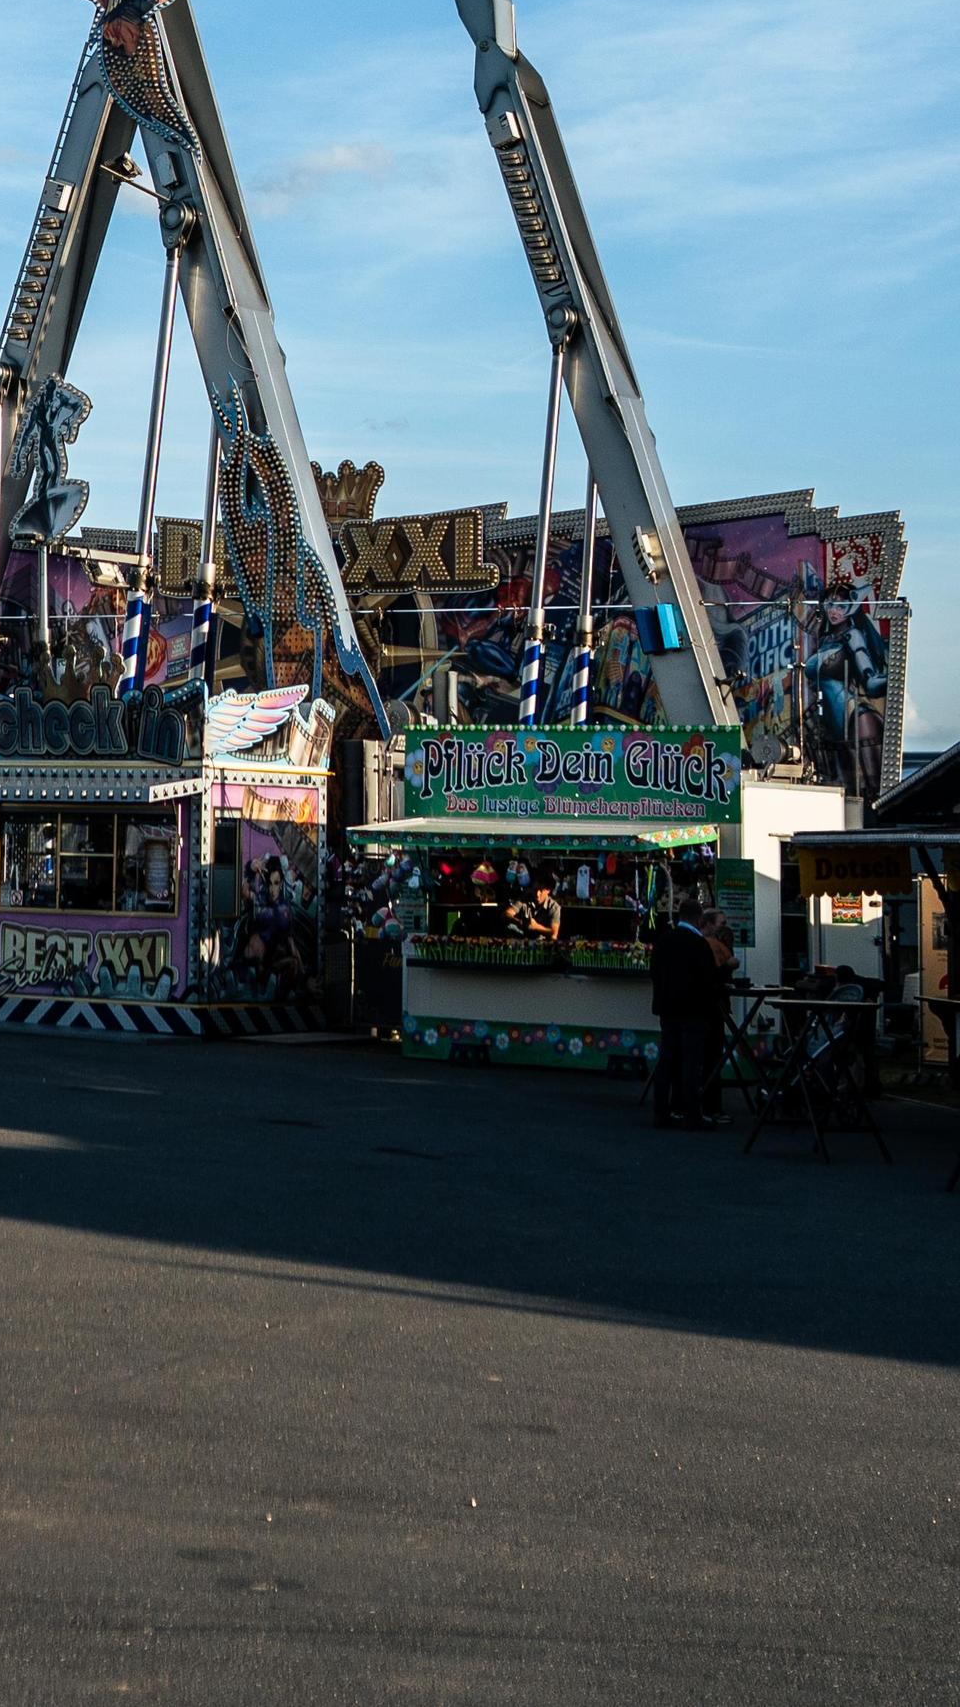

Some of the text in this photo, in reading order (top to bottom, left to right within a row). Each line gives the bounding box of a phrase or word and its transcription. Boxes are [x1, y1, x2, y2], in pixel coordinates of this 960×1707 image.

[342, 513, 497, 588] XXL
[747, 617, 792, 658] OUTH
[137, 684, 186, 766] in
[420, 738, 730, 805] Pflück Dein Glück
[446, 794, 706, 820] Das lustige Blümchenpflücken
[815, 856, 901, 881] Dotsch
[1, 922, 92, 972] BEST
